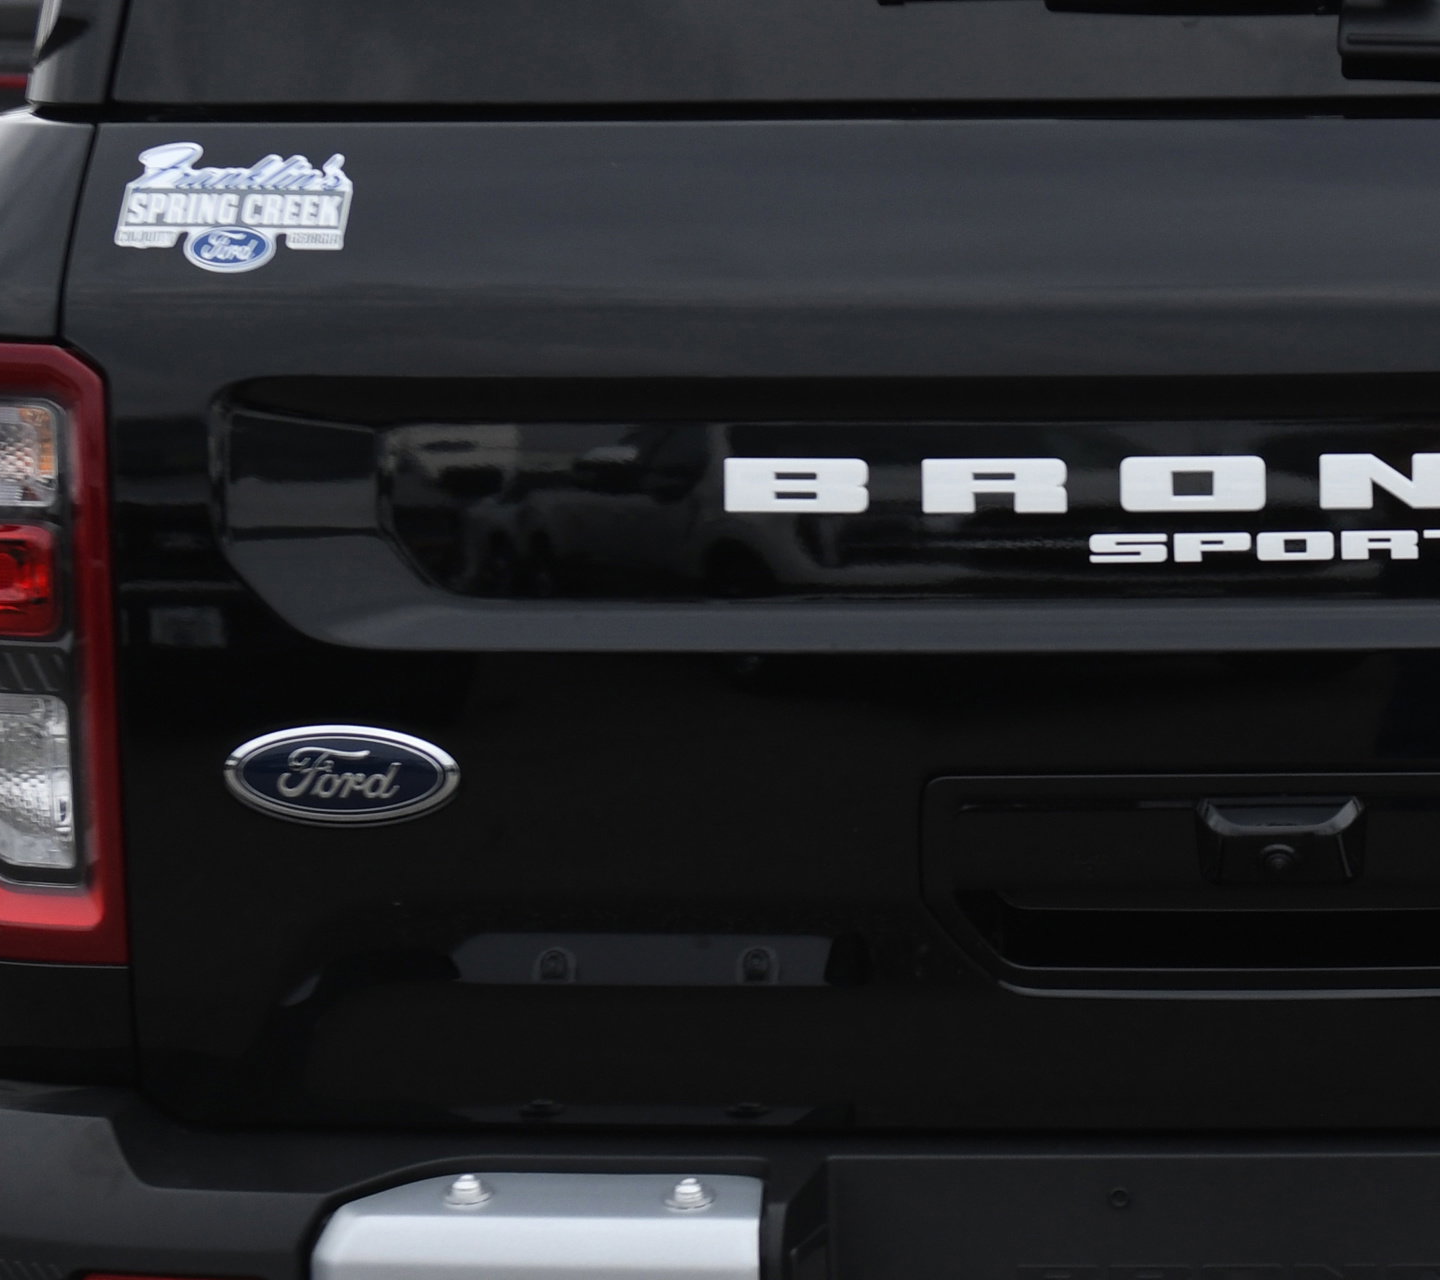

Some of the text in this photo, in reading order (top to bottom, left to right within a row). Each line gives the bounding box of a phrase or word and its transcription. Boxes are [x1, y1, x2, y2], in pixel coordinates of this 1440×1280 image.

[127, 192, 343, 226] SPRING CREEK
[203, 230, 258, 261] Ford
[276, 746, 402, 798] Ford
